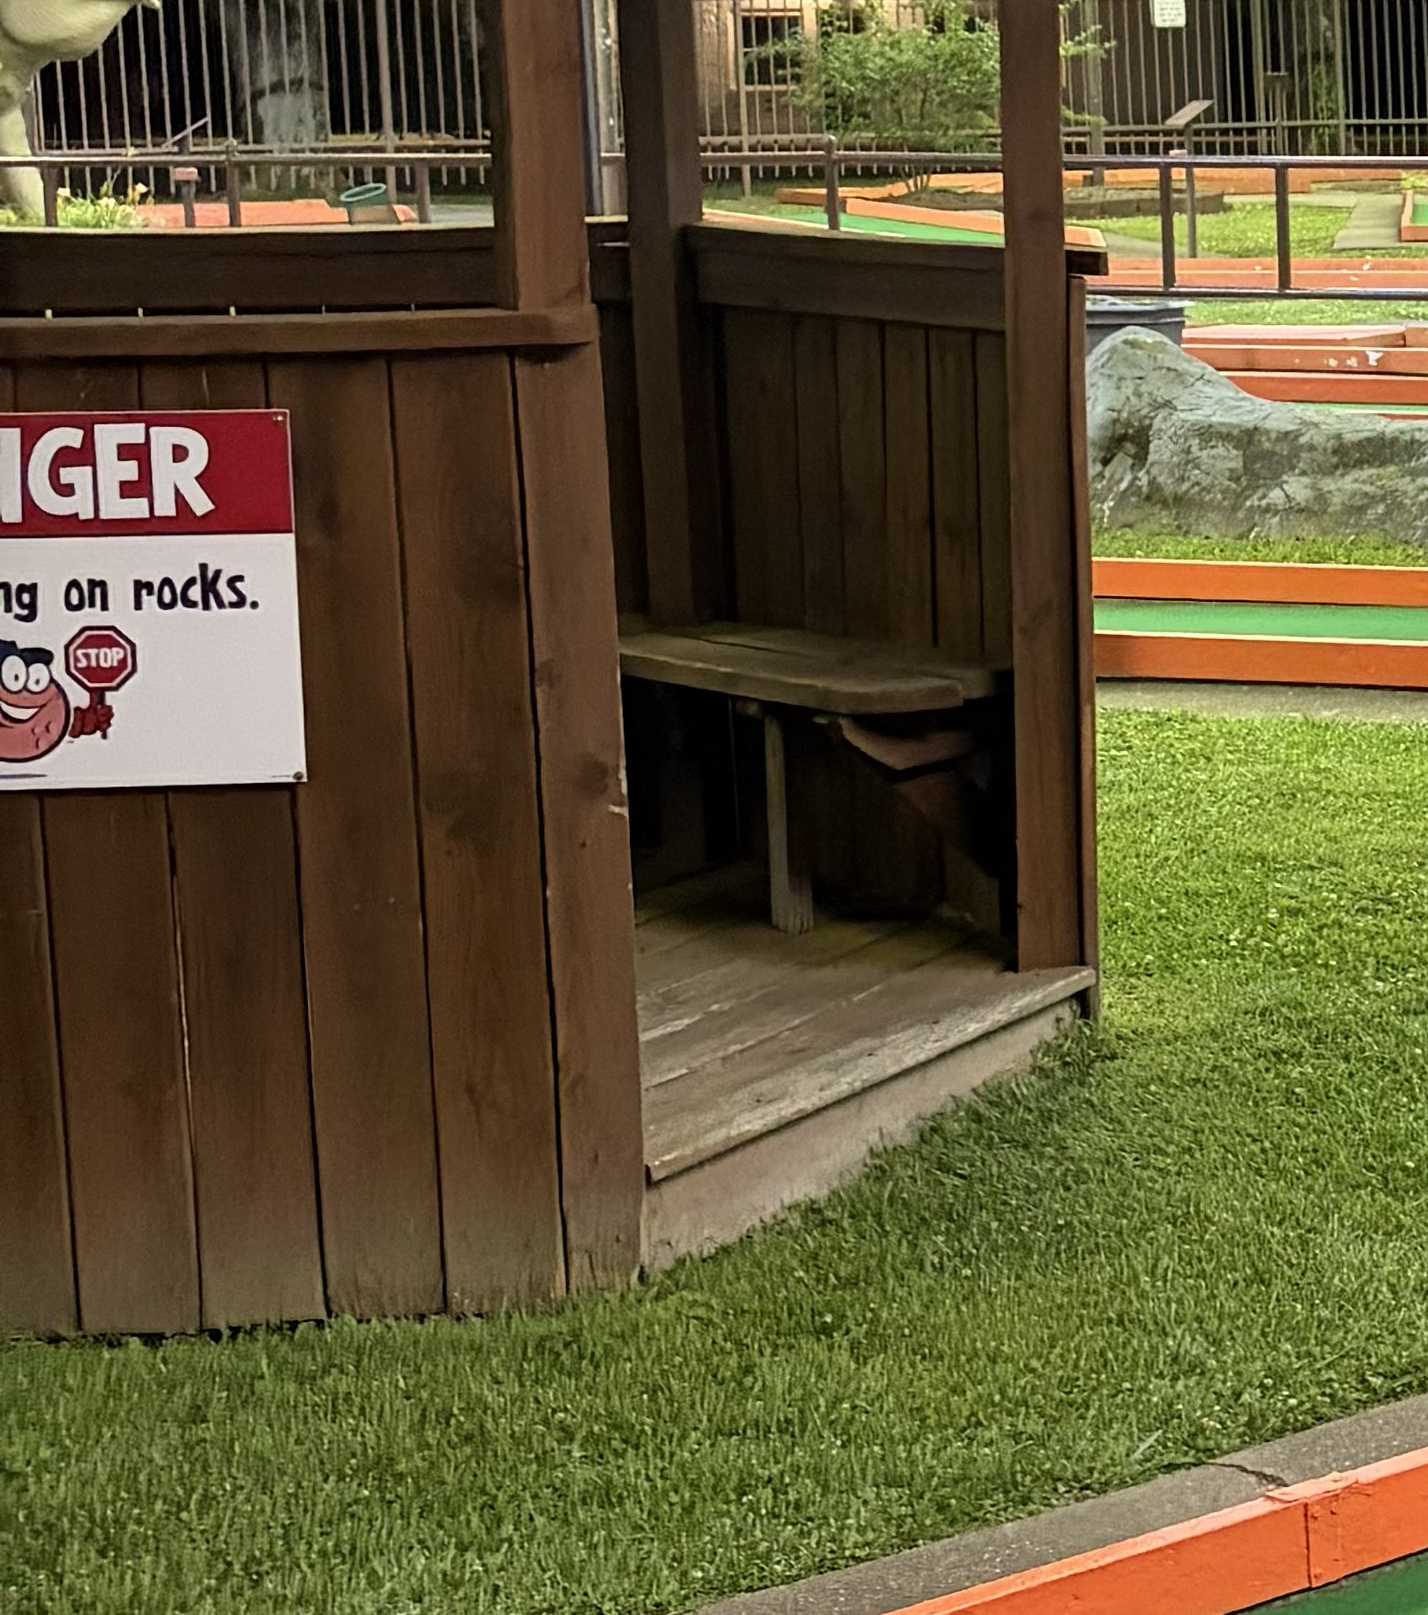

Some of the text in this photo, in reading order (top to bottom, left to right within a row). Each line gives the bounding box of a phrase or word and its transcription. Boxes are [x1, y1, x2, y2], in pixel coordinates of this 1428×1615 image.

[64, 578, 109, 612] on
[133, 562, 259, 611] rocks.
[76, 647, 124, 669] STOP
